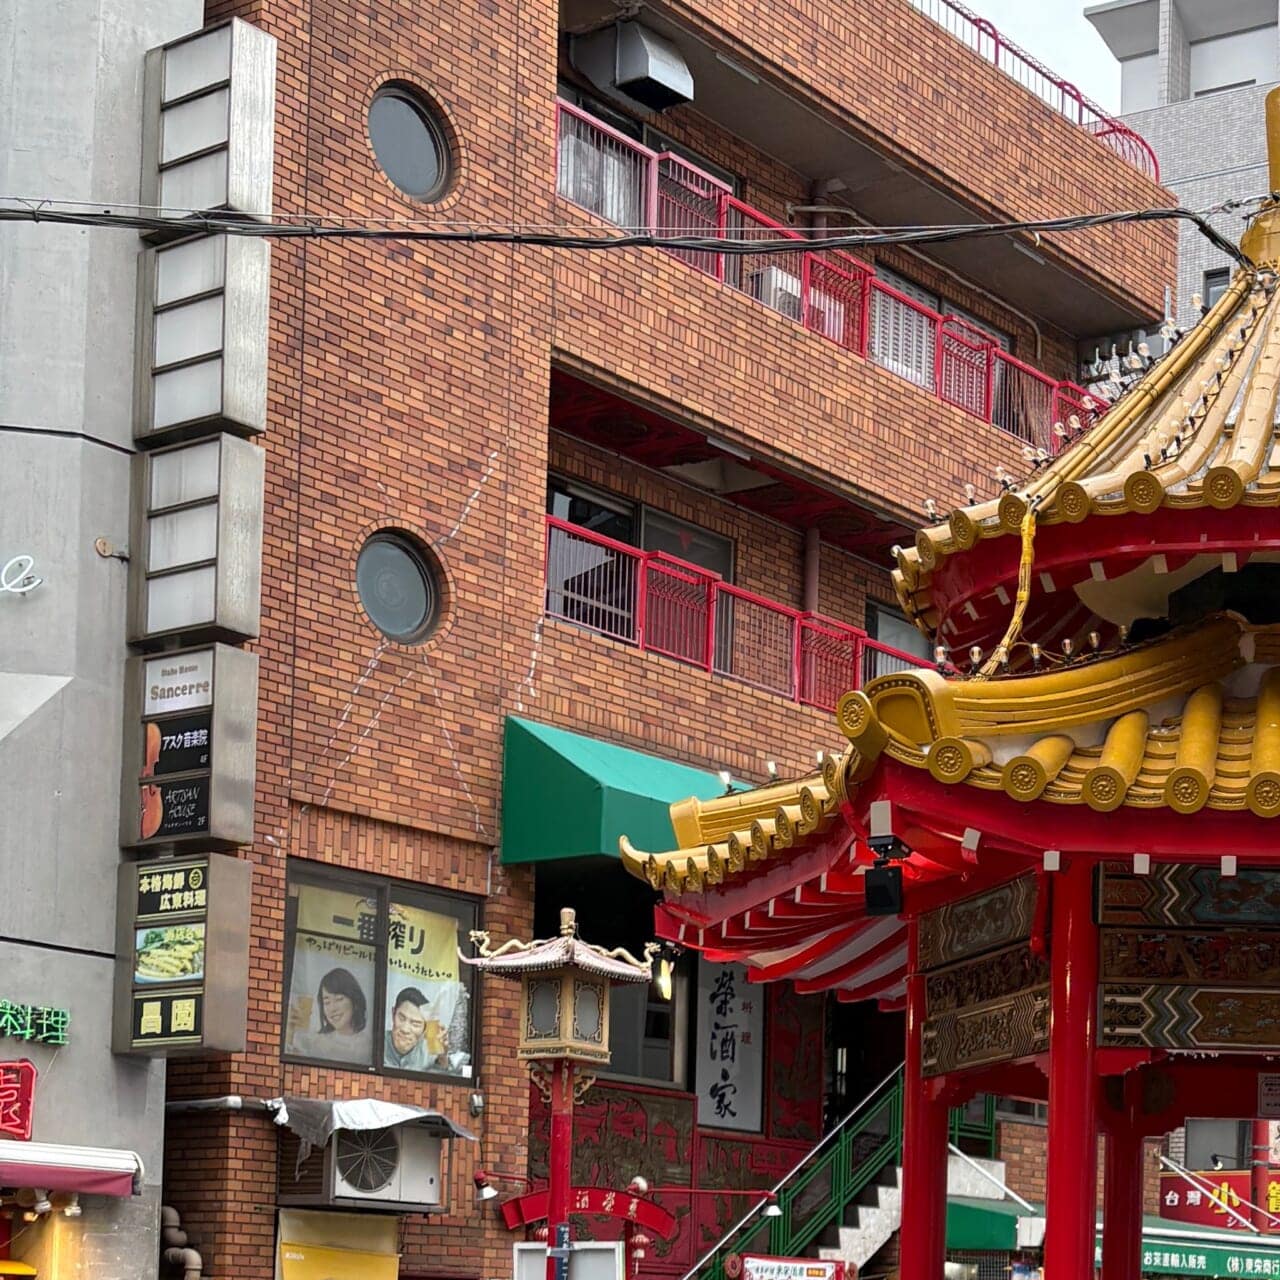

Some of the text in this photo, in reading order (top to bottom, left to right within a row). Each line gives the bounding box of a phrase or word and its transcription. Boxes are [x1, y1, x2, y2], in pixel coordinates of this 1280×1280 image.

[150, 679, 210, 701] Sancerre
[162, 728, 209, 751] アスク音楽院
